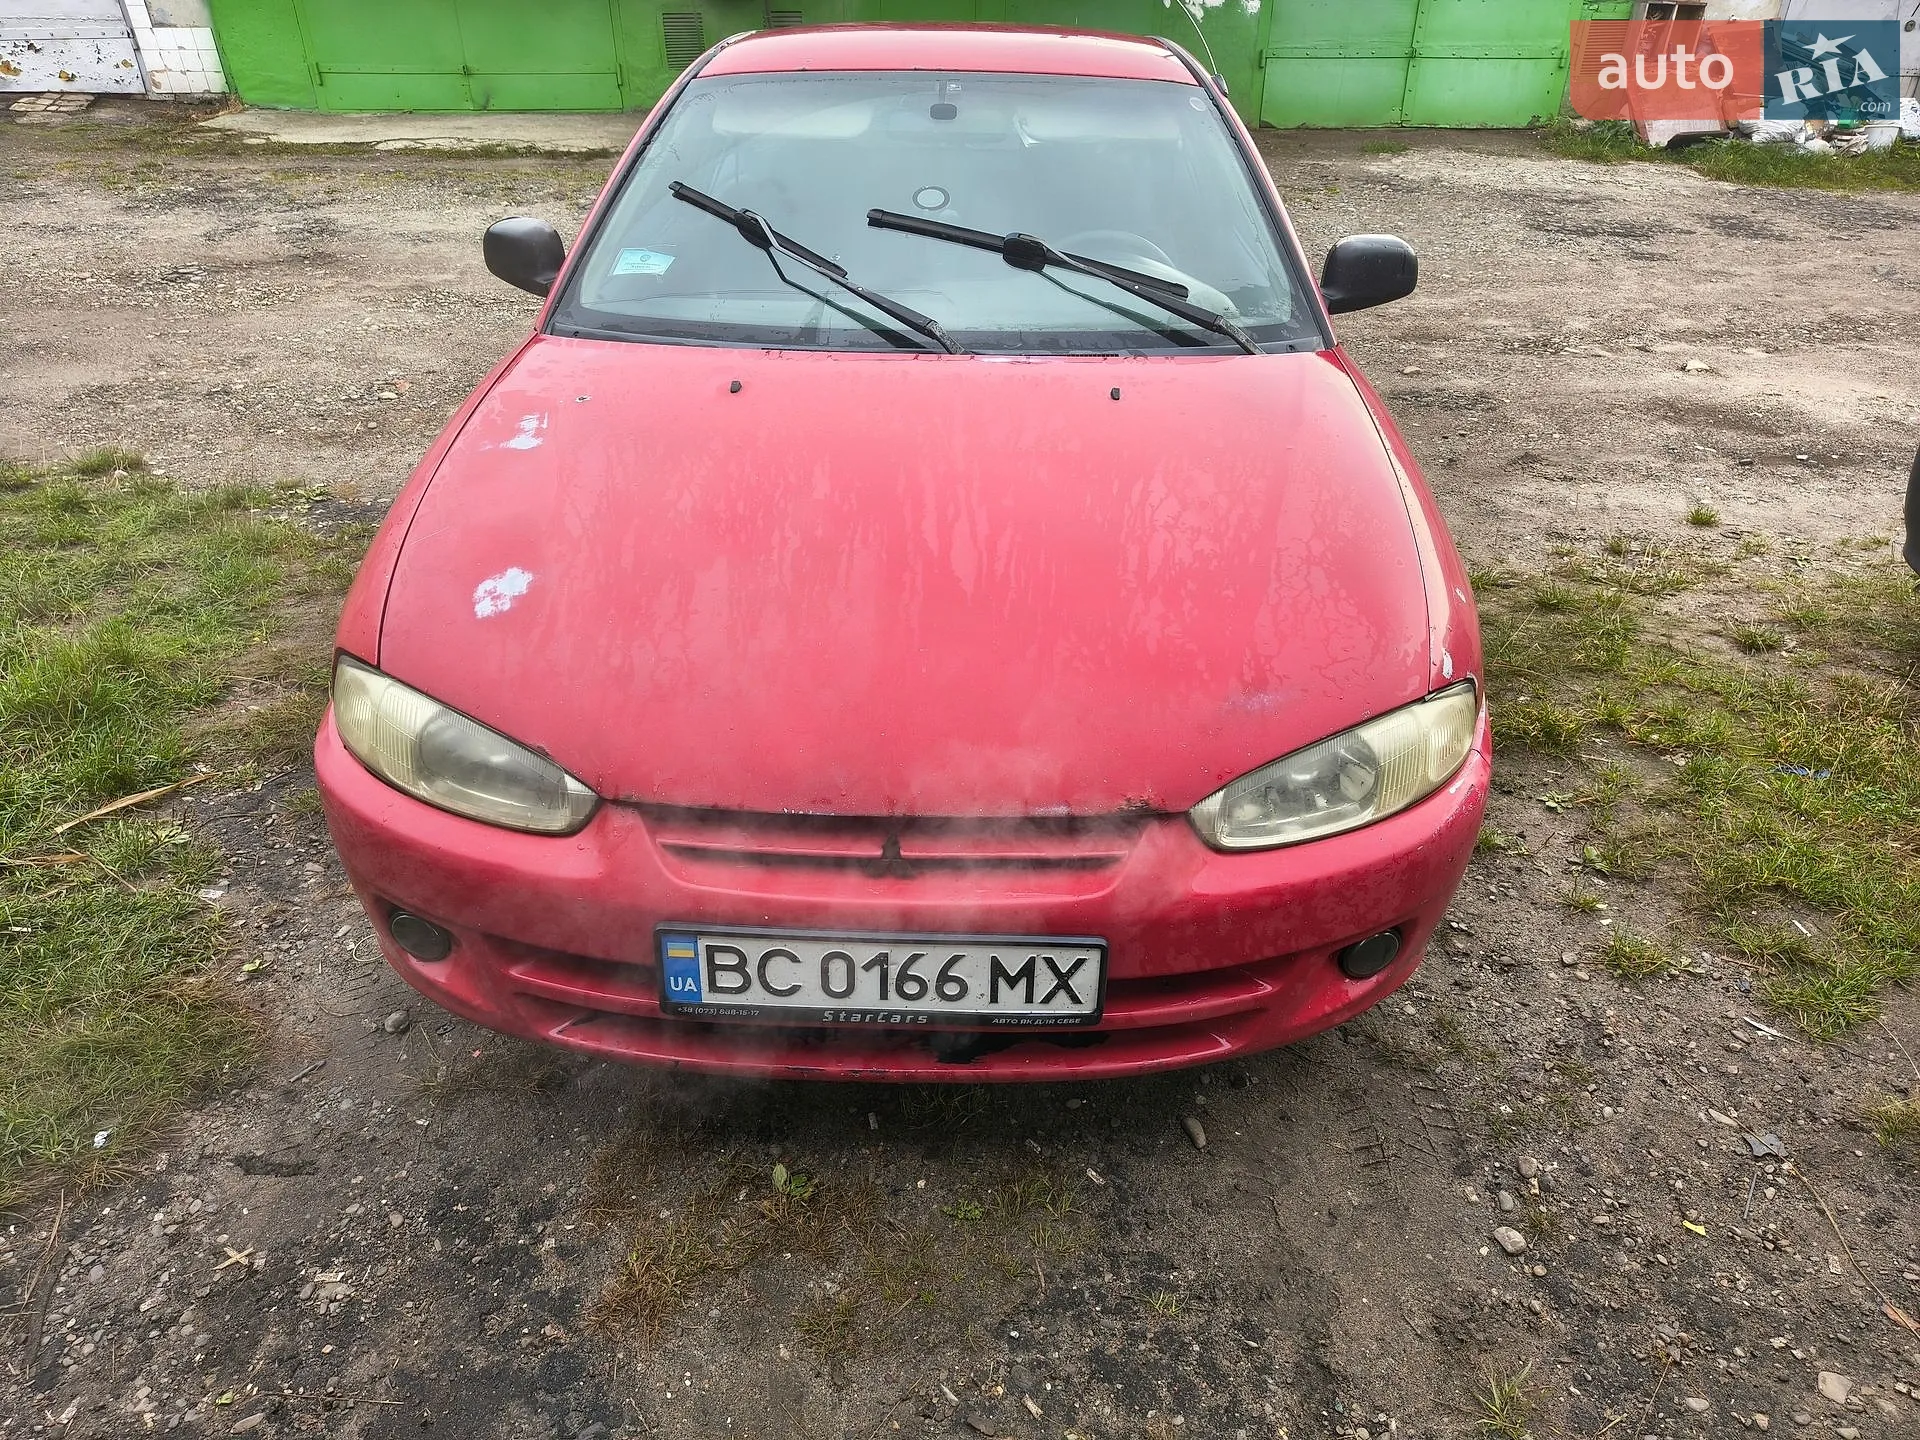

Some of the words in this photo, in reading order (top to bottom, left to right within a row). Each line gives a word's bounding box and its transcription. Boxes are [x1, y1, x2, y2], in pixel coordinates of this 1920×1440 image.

[705, 944, 802, 997] BC
[820, 951, 969, 1002] 0166
[989, 954, 1088, 1004] MX
[669, 976, 698, 992] UA
[822, 1010, 928, 1024] StarCars
